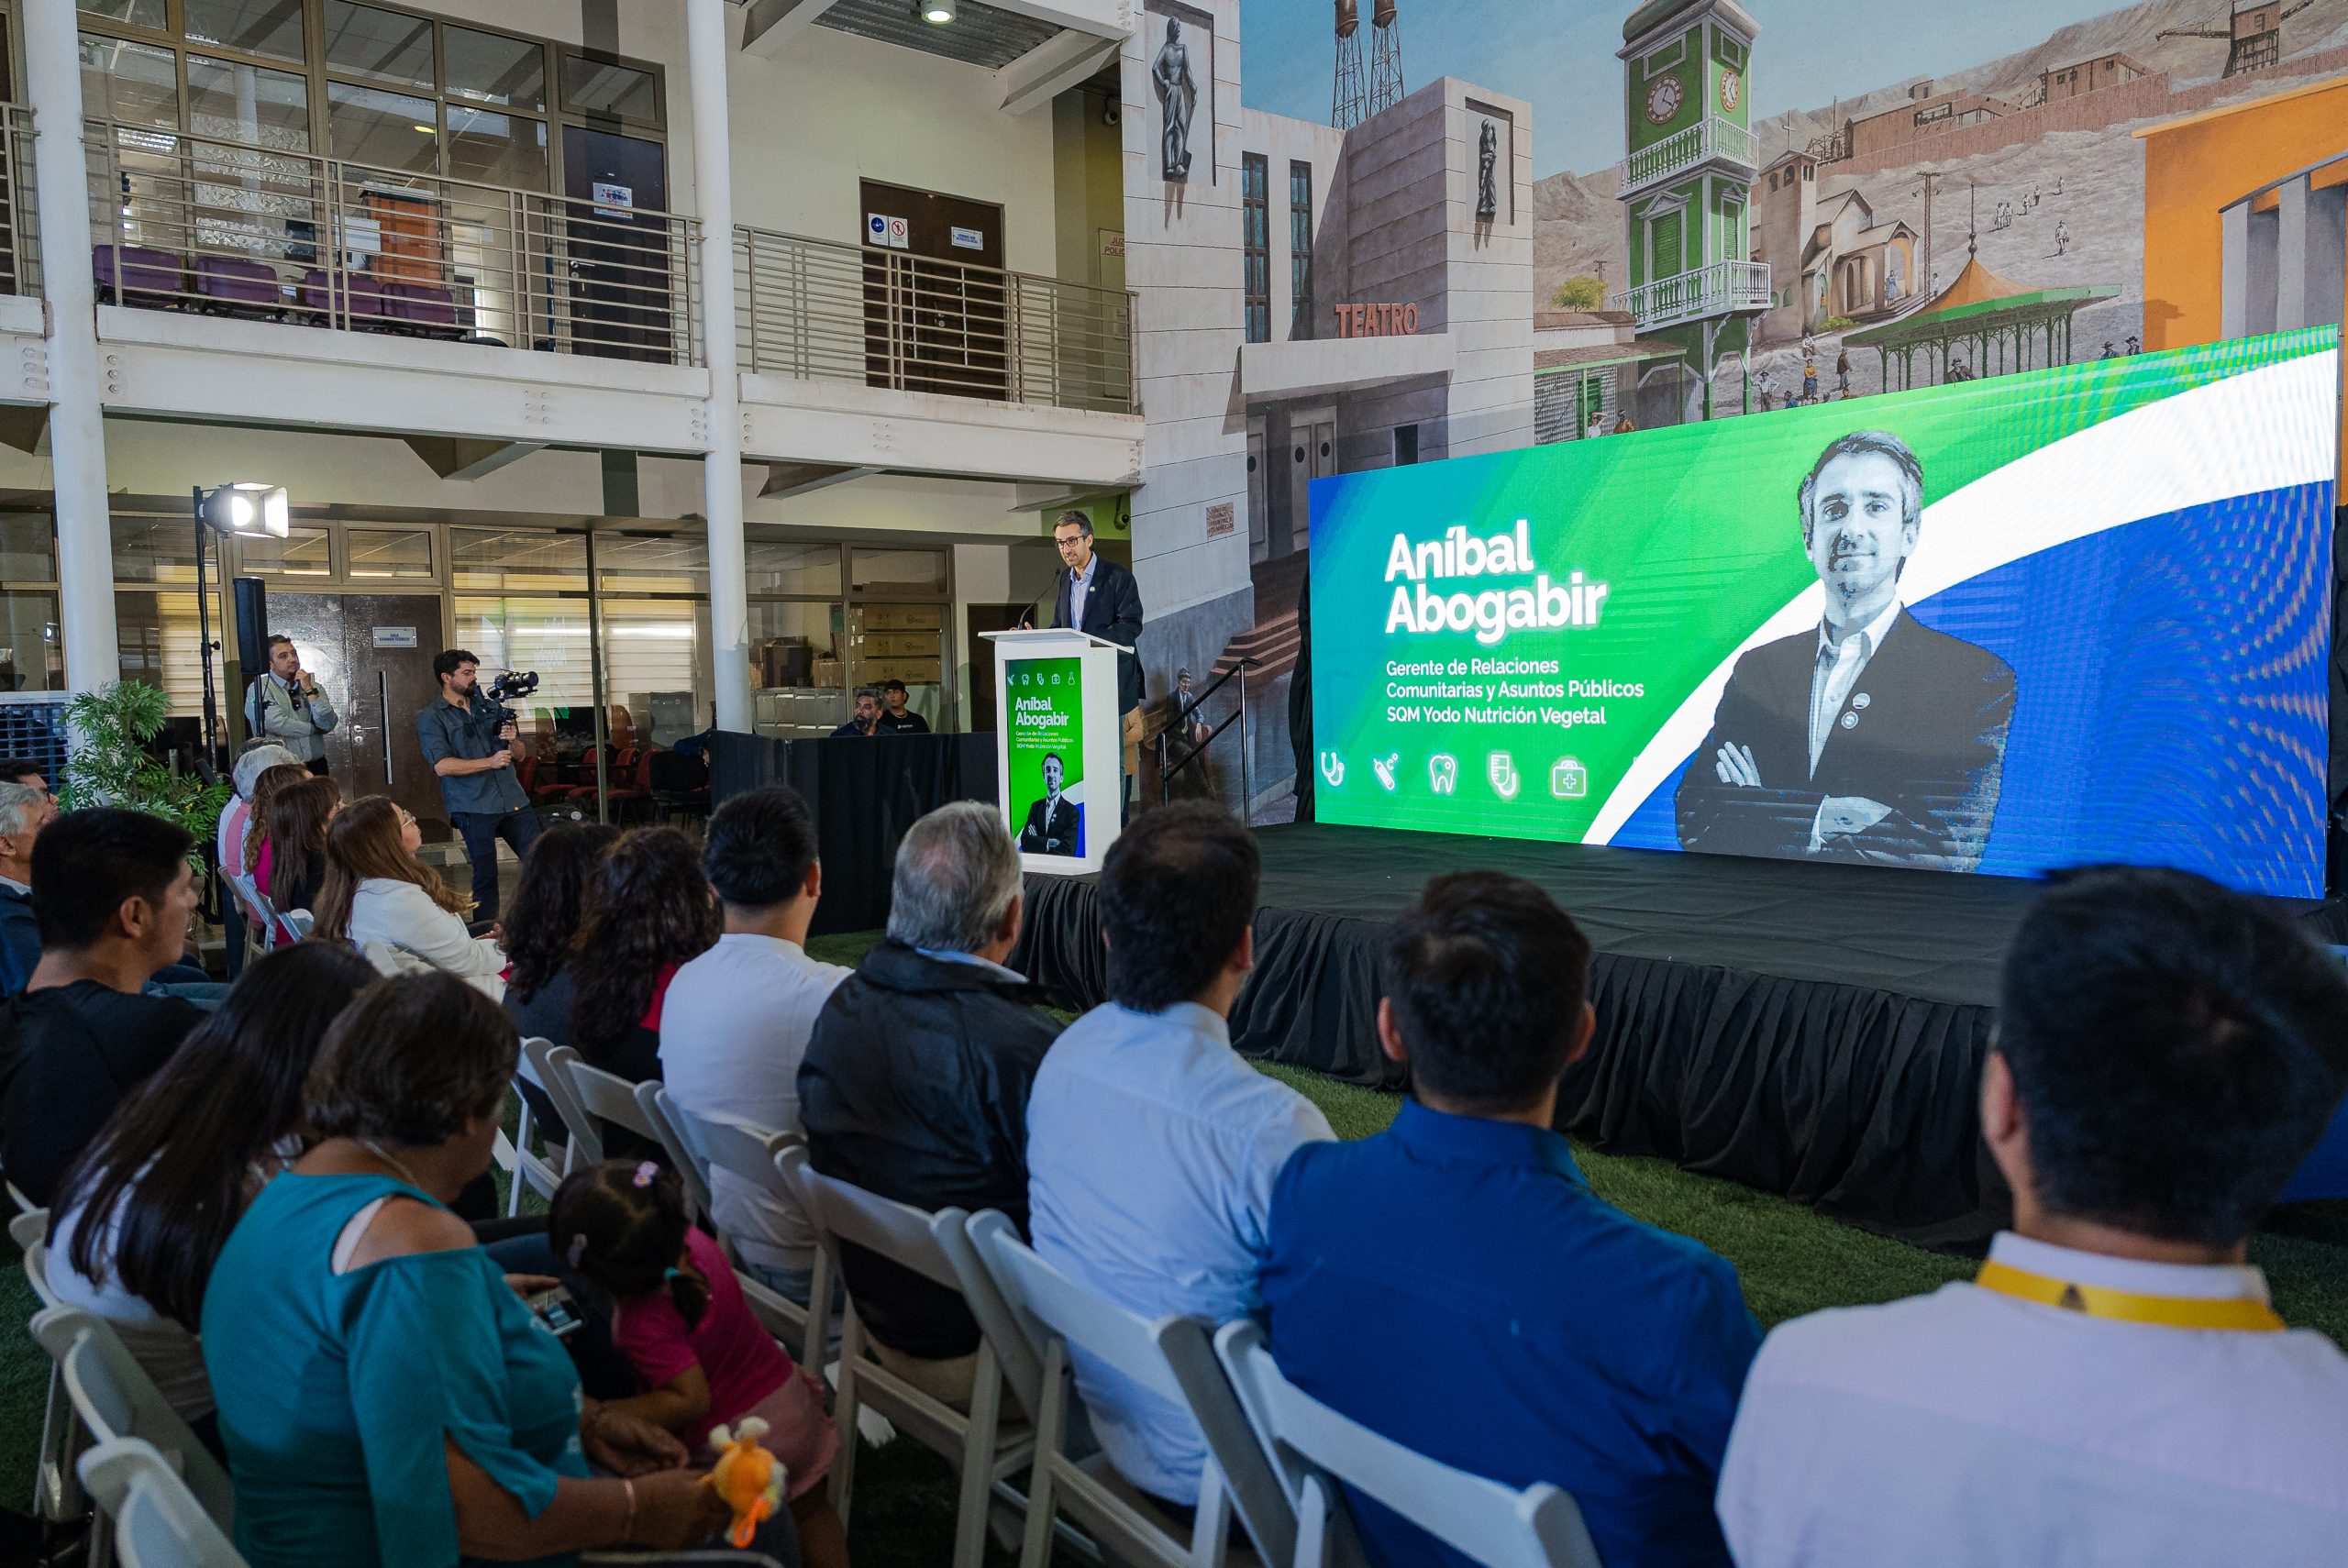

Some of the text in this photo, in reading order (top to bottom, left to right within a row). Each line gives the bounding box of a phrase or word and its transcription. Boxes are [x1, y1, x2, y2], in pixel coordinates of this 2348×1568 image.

[1334, 303, 1418, 338] TEATRO
[1384, 519, 1534, 582] Aníbal
[1385, 571, 1607, 644] Abogabir
[1386, 657, 1559, 677] Gerente de Relaciones
[1386, 679, 1645, 701] Comunitarias y Asuntos Públicos
[1015, 711, 1069, 730] Abogabir
[1387, 705, 1607, 729] SQM Yodo Nutrición Vegetal
